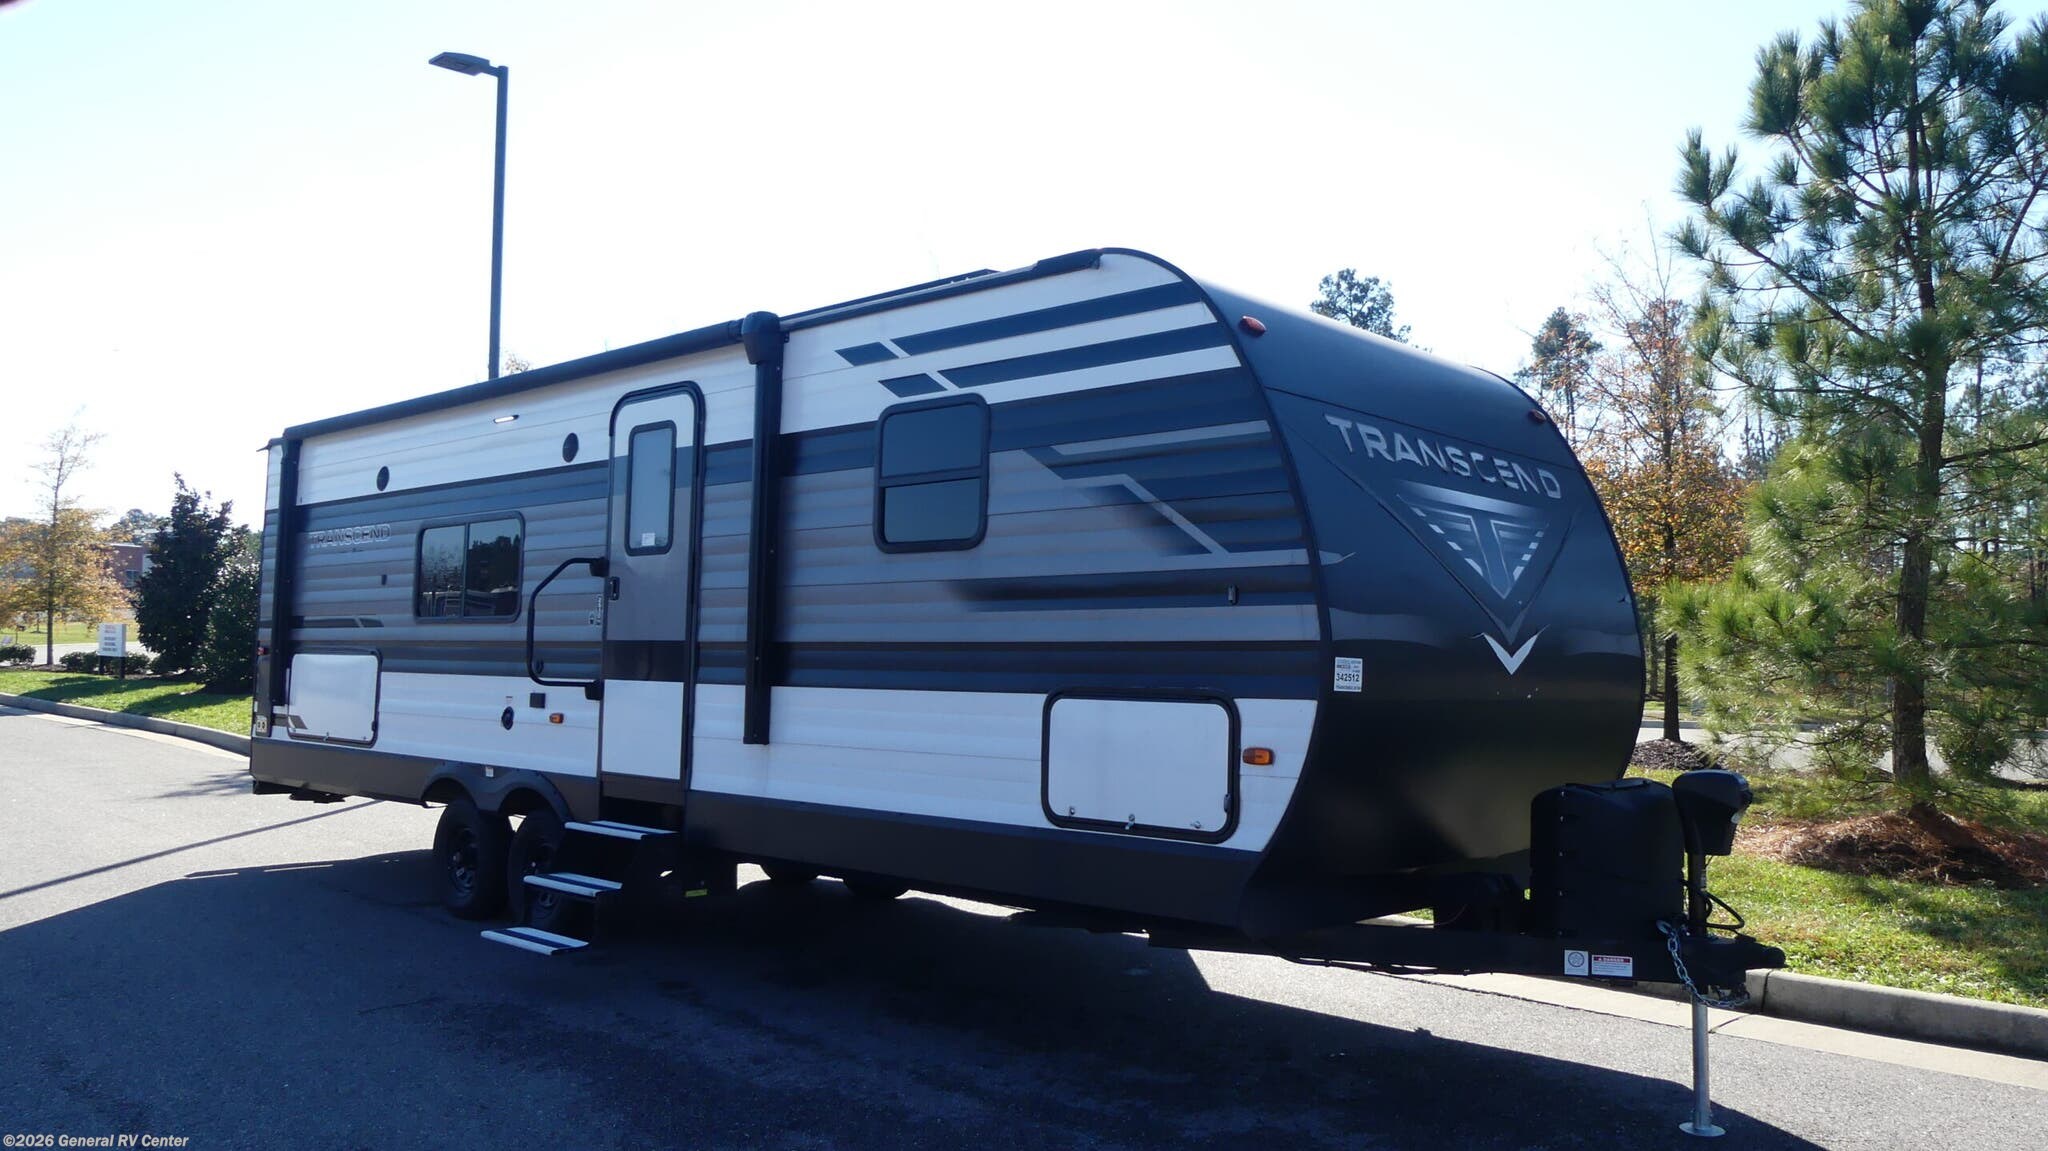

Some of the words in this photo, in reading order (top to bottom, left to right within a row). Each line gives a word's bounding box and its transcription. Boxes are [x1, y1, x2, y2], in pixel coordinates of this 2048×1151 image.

[1324, 413, 1562, 500] TRANSCEND
[309, 523, 392, 549] TRANSCEND
[1335, 672, 1361, 683] 342512
